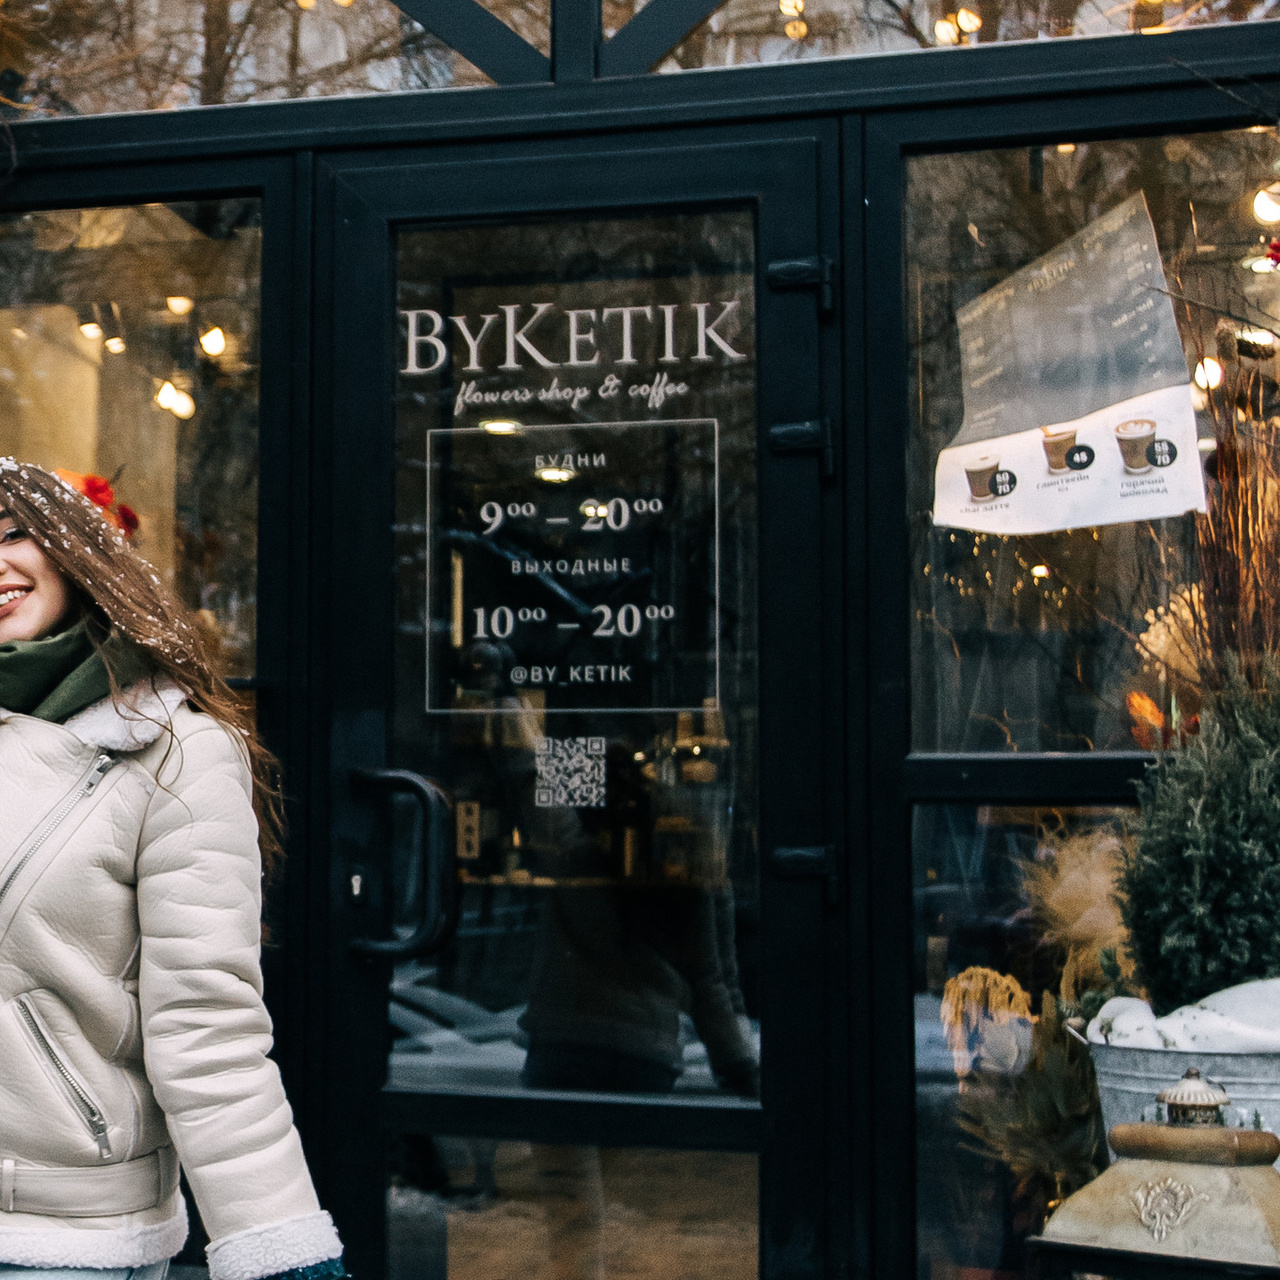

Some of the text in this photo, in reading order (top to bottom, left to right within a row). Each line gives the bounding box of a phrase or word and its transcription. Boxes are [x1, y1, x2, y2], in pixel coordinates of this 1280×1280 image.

[454, 372, 690, 416] flowers shop & coffee
[535, 452, 607, 470] БУДНИ
[511, 557, 632, 576] ВЫХОДНЫЕ
[510, 665, 632, 686] @BY_KETIK
